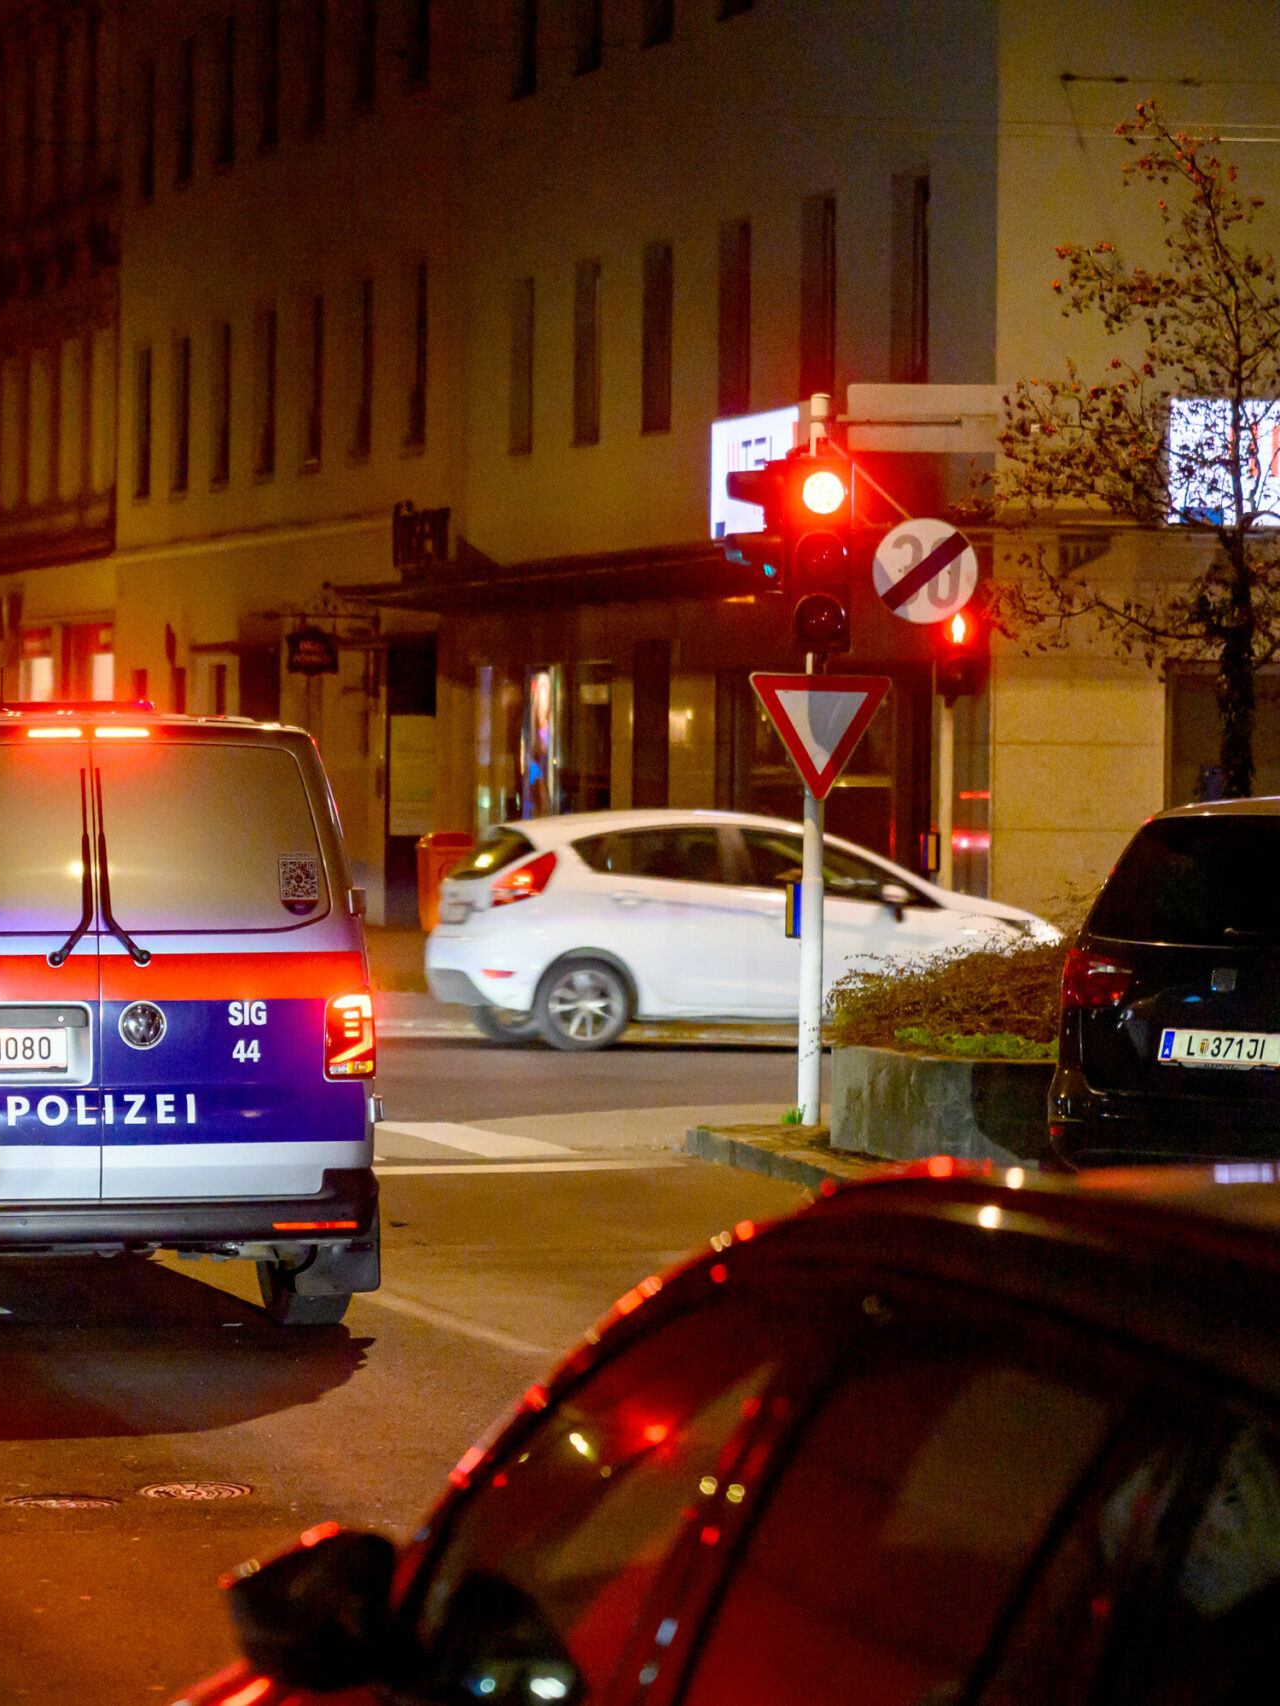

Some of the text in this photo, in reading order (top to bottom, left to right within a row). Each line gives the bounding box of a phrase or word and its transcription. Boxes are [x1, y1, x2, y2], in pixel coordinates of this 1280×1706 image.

[891, 534, 962, 610] 30
[228, 1001, 267, 1026] SIG
[232, 1039, 261, 1063] 44
[1186, 1035, 1195, 1056] L
[6, 1093, 196, 1127] POLIZEI
